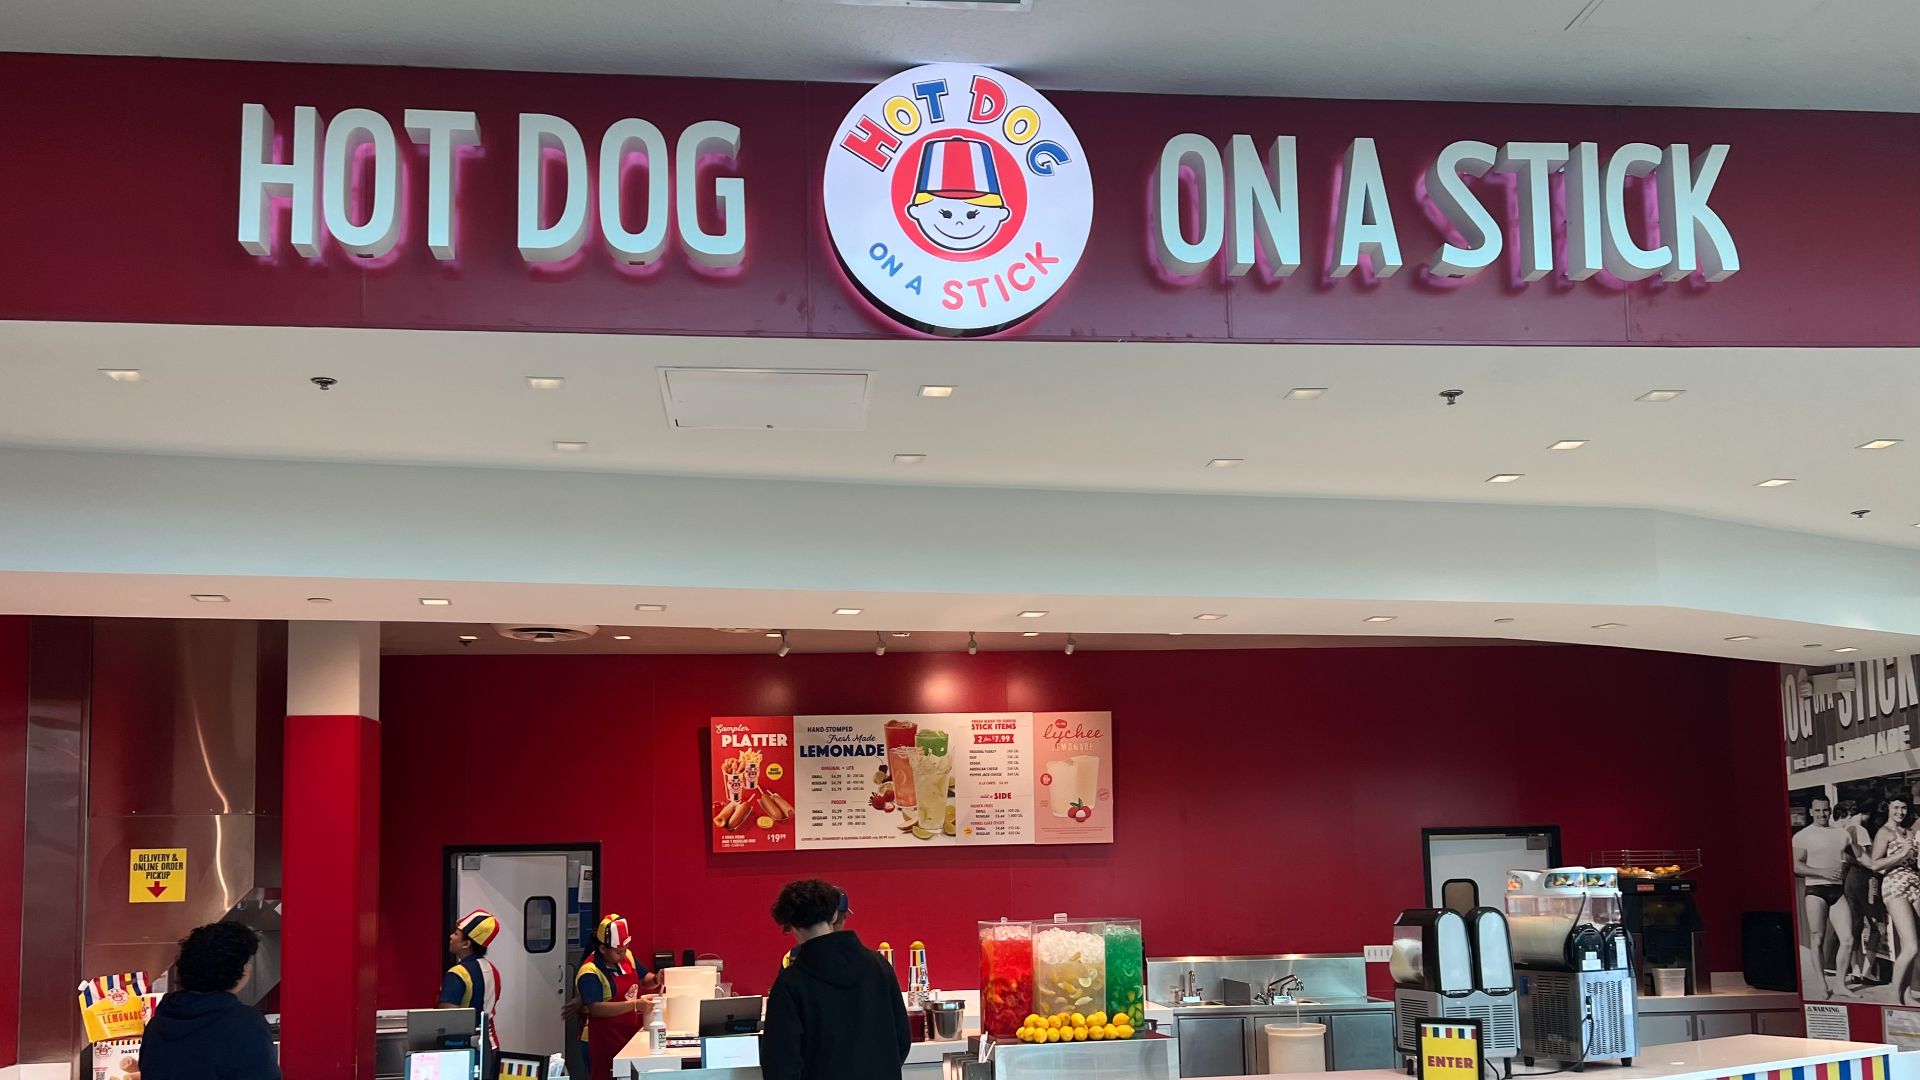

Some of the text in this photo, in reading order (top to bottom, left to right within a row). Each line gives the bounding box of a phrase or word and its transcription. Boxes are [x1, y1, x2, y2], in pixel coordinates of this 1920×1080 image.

[840, 75, 1073, 177] HOT DOG
[238, 103, 746, 267] HOT DOG
[1158, 132, 1740, 282] ON A STICK
[869, 241, 1060, 311] ON A STICK
[1781, 668, 1813, 741] OG
[715, 723, 750, 734] Sampler
[721, 733, 788, 748] PLATTER
[827, 734, 876, 744] Fresh Made
[1043, 723, 1103, 749] lychee
[800, 744, 884, 758] LEMONADE
[1051, 742, 1093, 751] LEMONADE
[138, 853, 178, 862] DELIVERY &
[133, 862, 183, 871] ONLINE ORDER
[145, 871, 170, 879] PICKUP
[1427, 1055, 1474, 1069] ENTER
